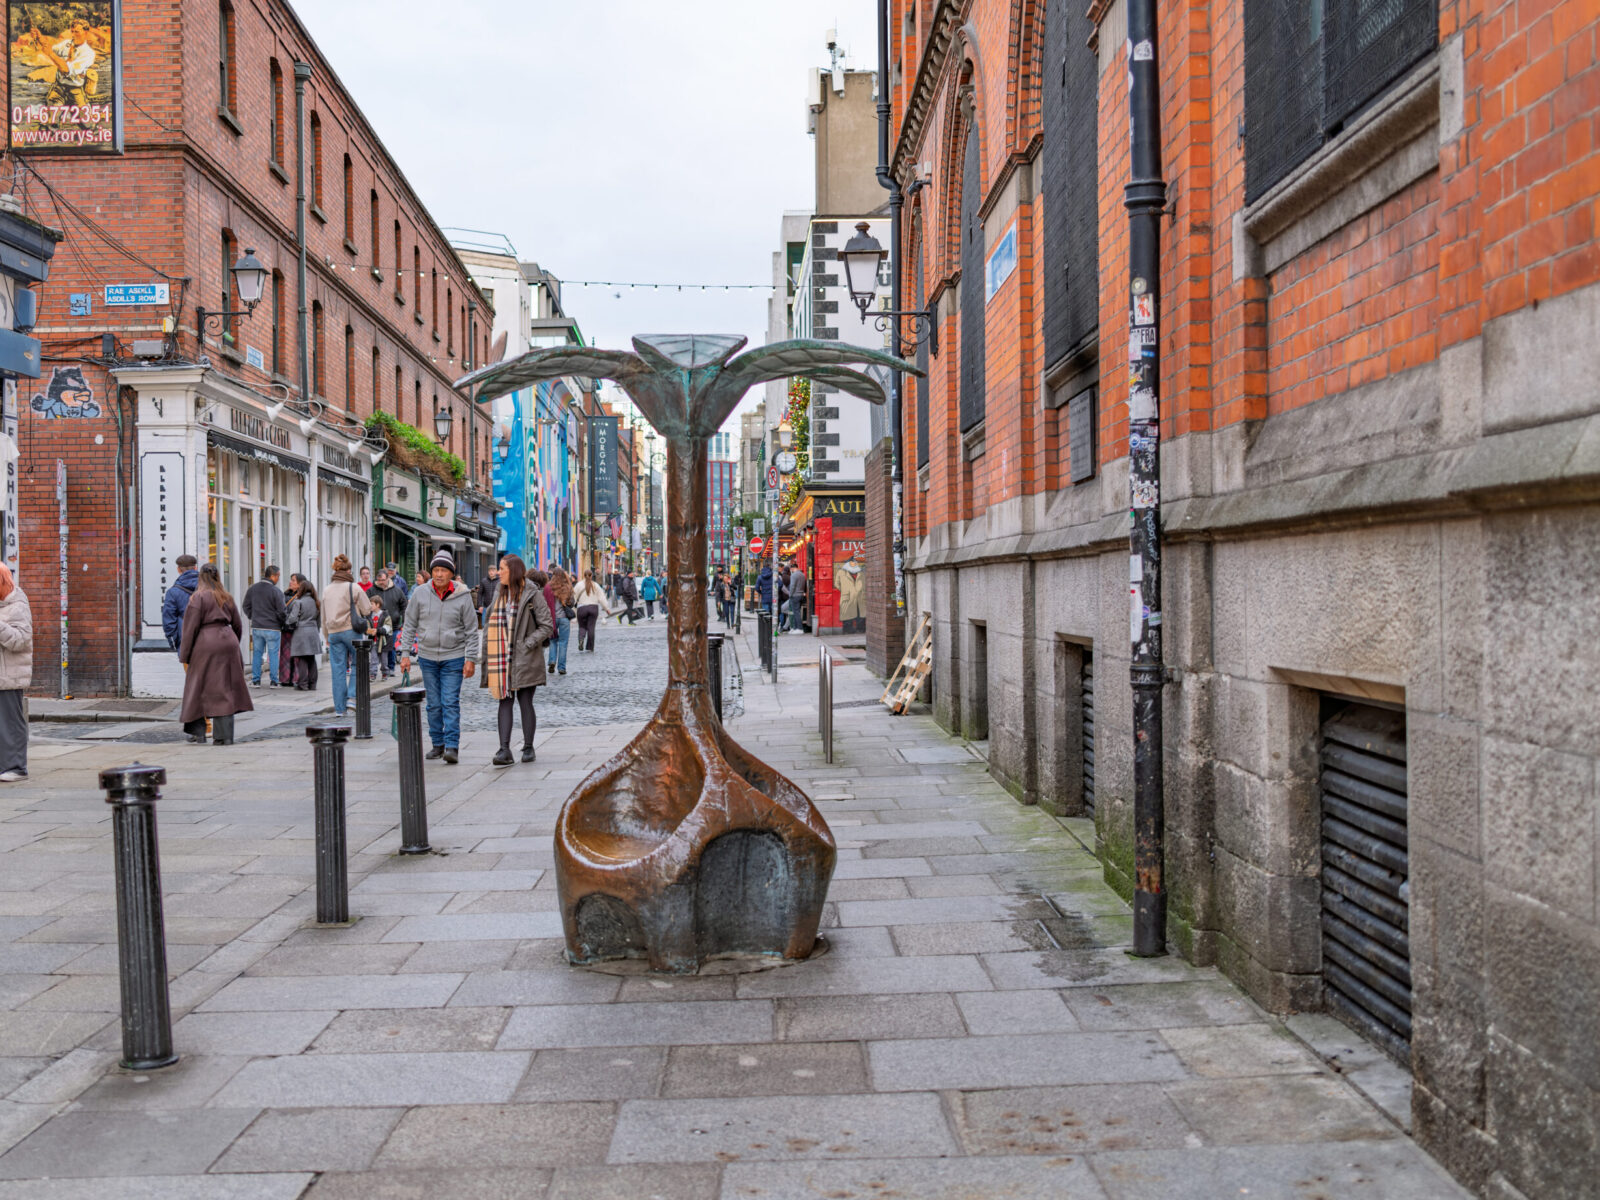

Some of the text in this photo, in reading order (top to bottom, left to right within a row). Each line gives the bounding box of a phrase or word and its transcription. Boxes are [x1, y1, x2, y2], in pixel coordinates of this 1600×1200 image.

[12, 105, 110, 124] 01-6772351
[12, 126, 112, 146] www.rorys.ie
[109, 287, 125, 295] RAE
[159, 289, 165, 299] 2
[599, 428, 607, 474] MORGAN
[7, 427, 16, 546] FSHING
[159, 465, 168, 541] ELEPHANT
